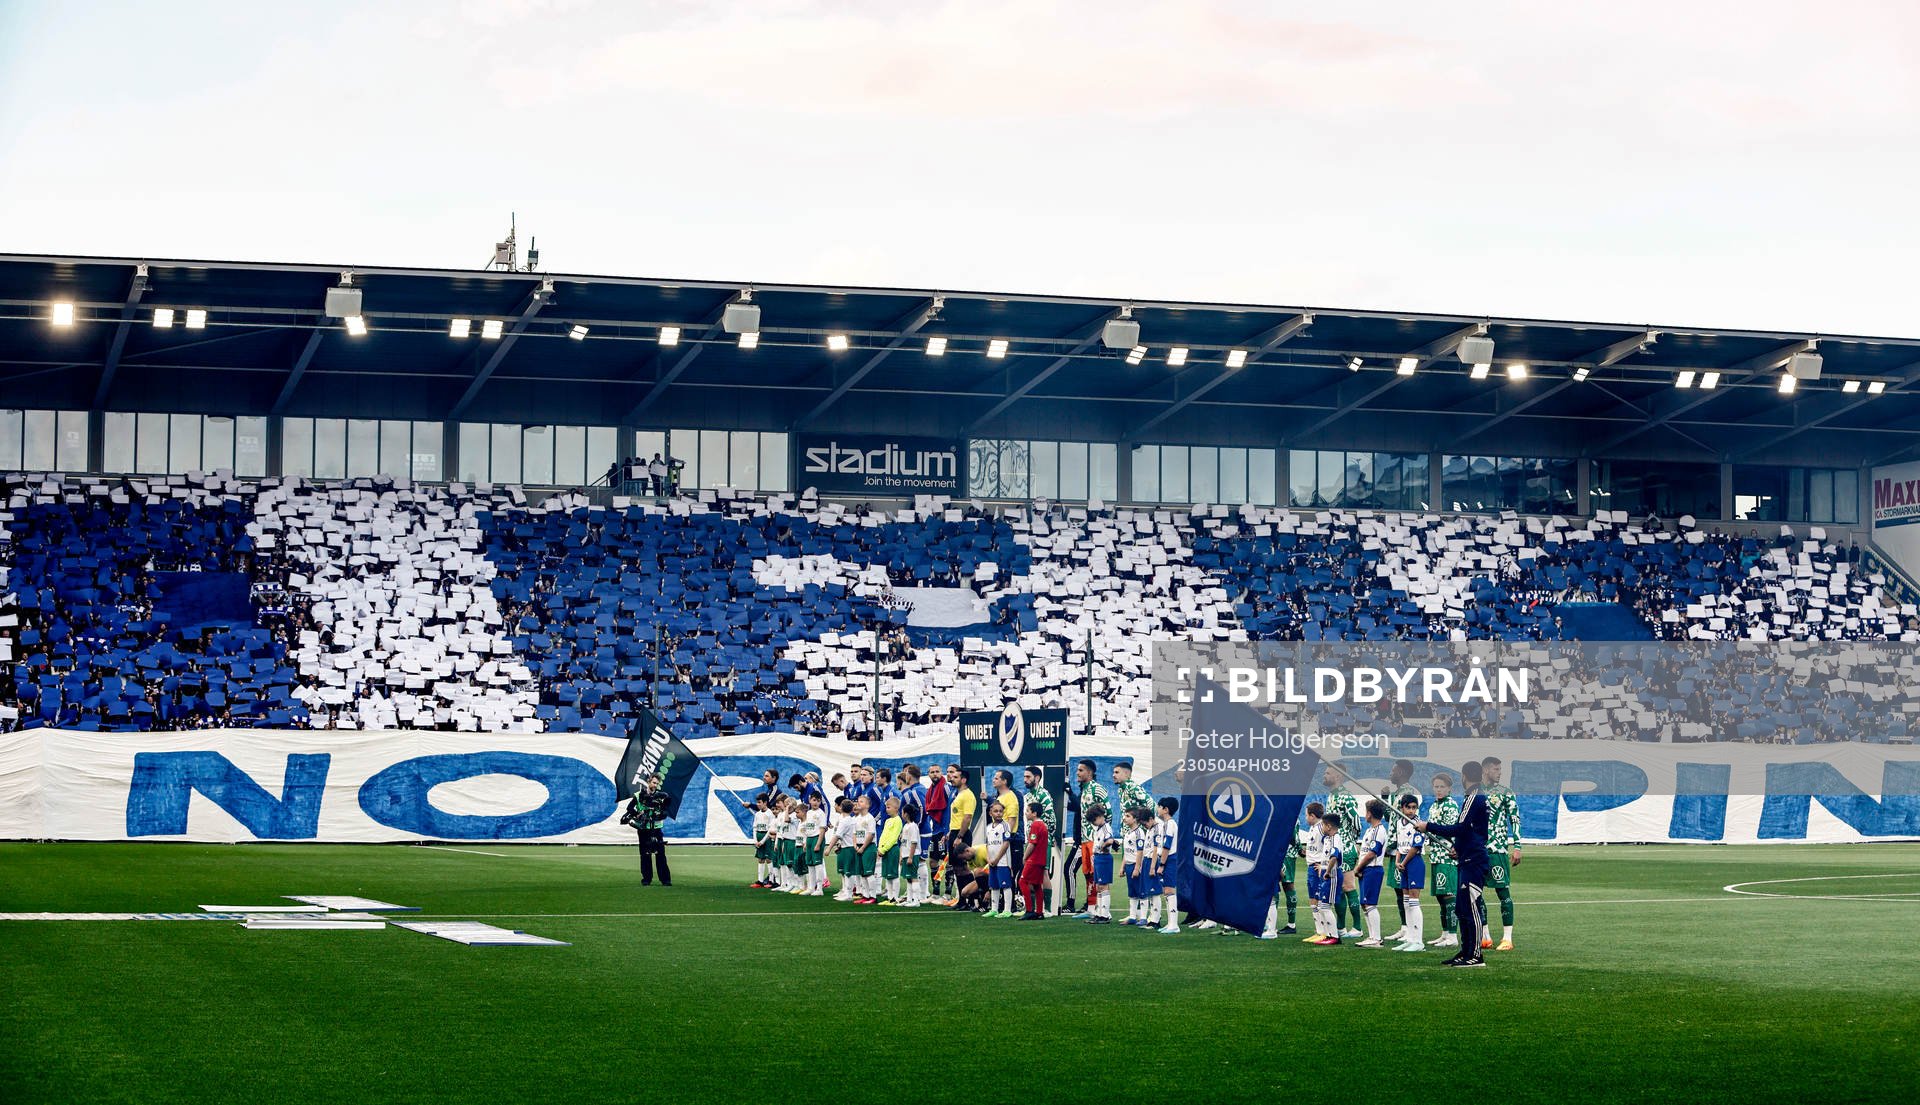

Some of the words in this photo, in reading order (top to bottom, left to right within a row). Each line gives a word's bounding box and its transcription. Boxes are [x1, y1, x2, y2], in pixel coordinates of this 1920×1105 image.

[805, 441, 956, 477] stadium
[864, 477, 883, 487] Join
[885, 478, 901, 487] the
[903, 479, 956, 489] movement
[965, 724, 994, 740] UNIBET
[1029, 722, 1061, 738] UNIBET
[1193, 821, 1253, 854] LLSVENSKAN
[1194, 846, 1233, 868] UNIBET
